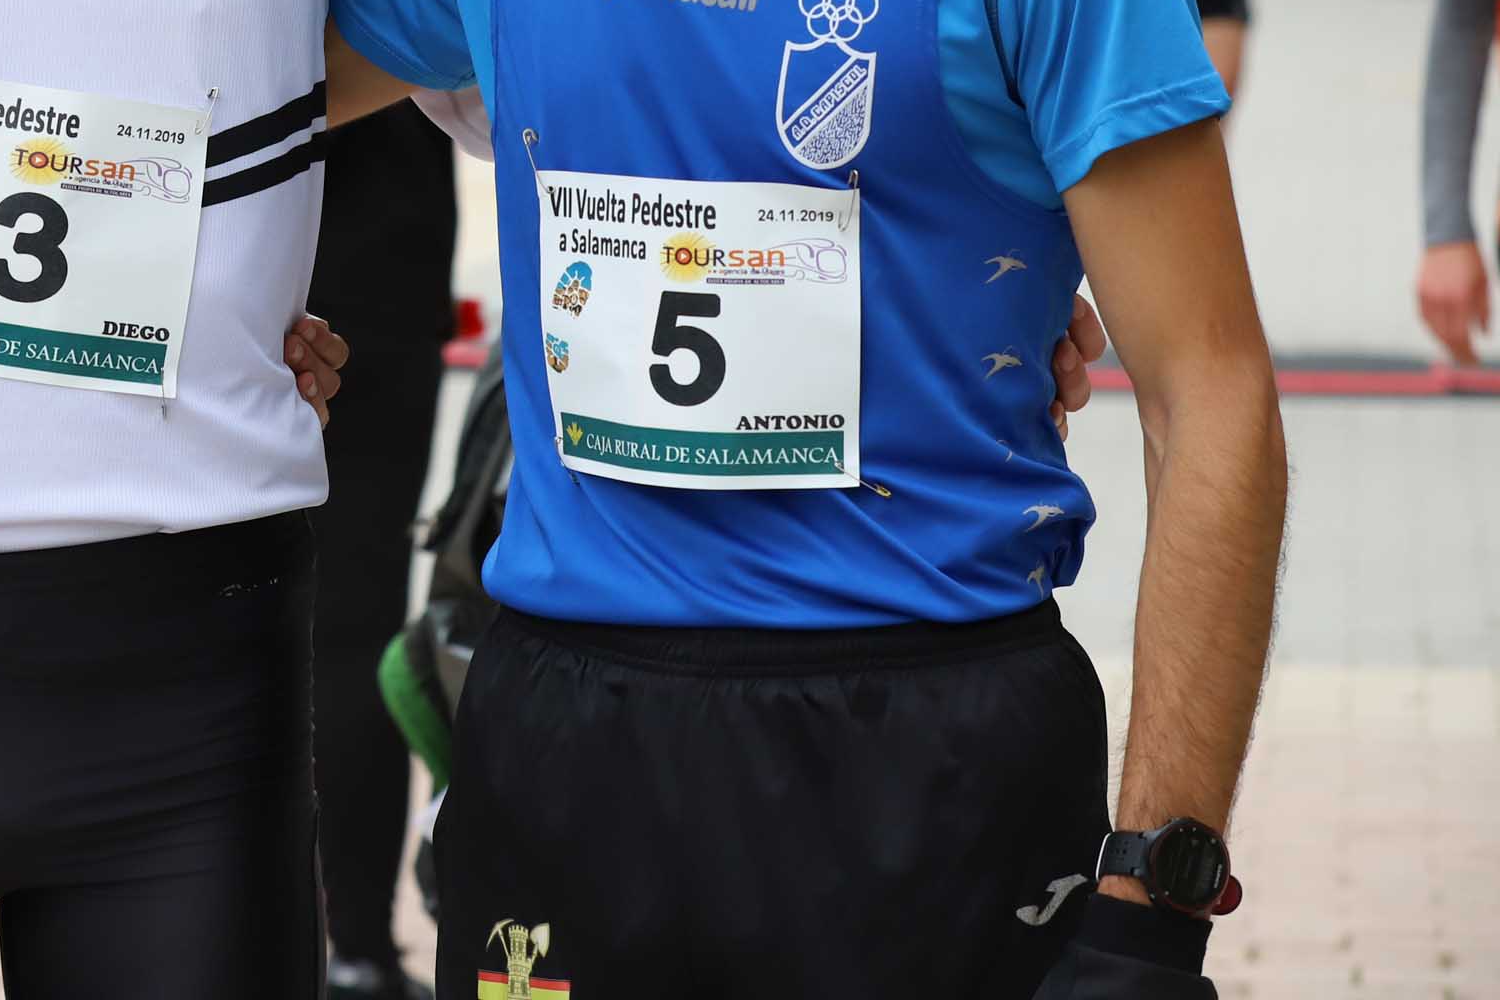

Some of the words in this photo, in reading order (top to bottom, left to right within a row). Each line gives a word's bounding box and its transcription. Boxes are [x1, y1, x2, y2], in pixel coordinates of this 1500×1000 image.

[811, 65, 867, 119] CAPISCOL
[117, 124, 185, 144] 24.11.2019
[549, 187, 571, 217] VII
[576, 188, 626, 222] Vuelta
[632, 193, 717, 230] Pedestre
[758, 209, 834, 223] 24.11.2019
[559, 234, 567, 252] a
[571, 227, 647, 260] Salamanca
[102, 321, 170, 341] DIEGO
[25, 343, 159, 374] SALAMANCA
[649, 290, 726, 407] 5
[736, 415, 845, 431] ANTONIO
[586, 433, 613, 456] CAJA
[615, 439, 661, 461] RURAL
[665, 446, 690, 463] DE
[695, 447, 839, 466] SALAMANCA
